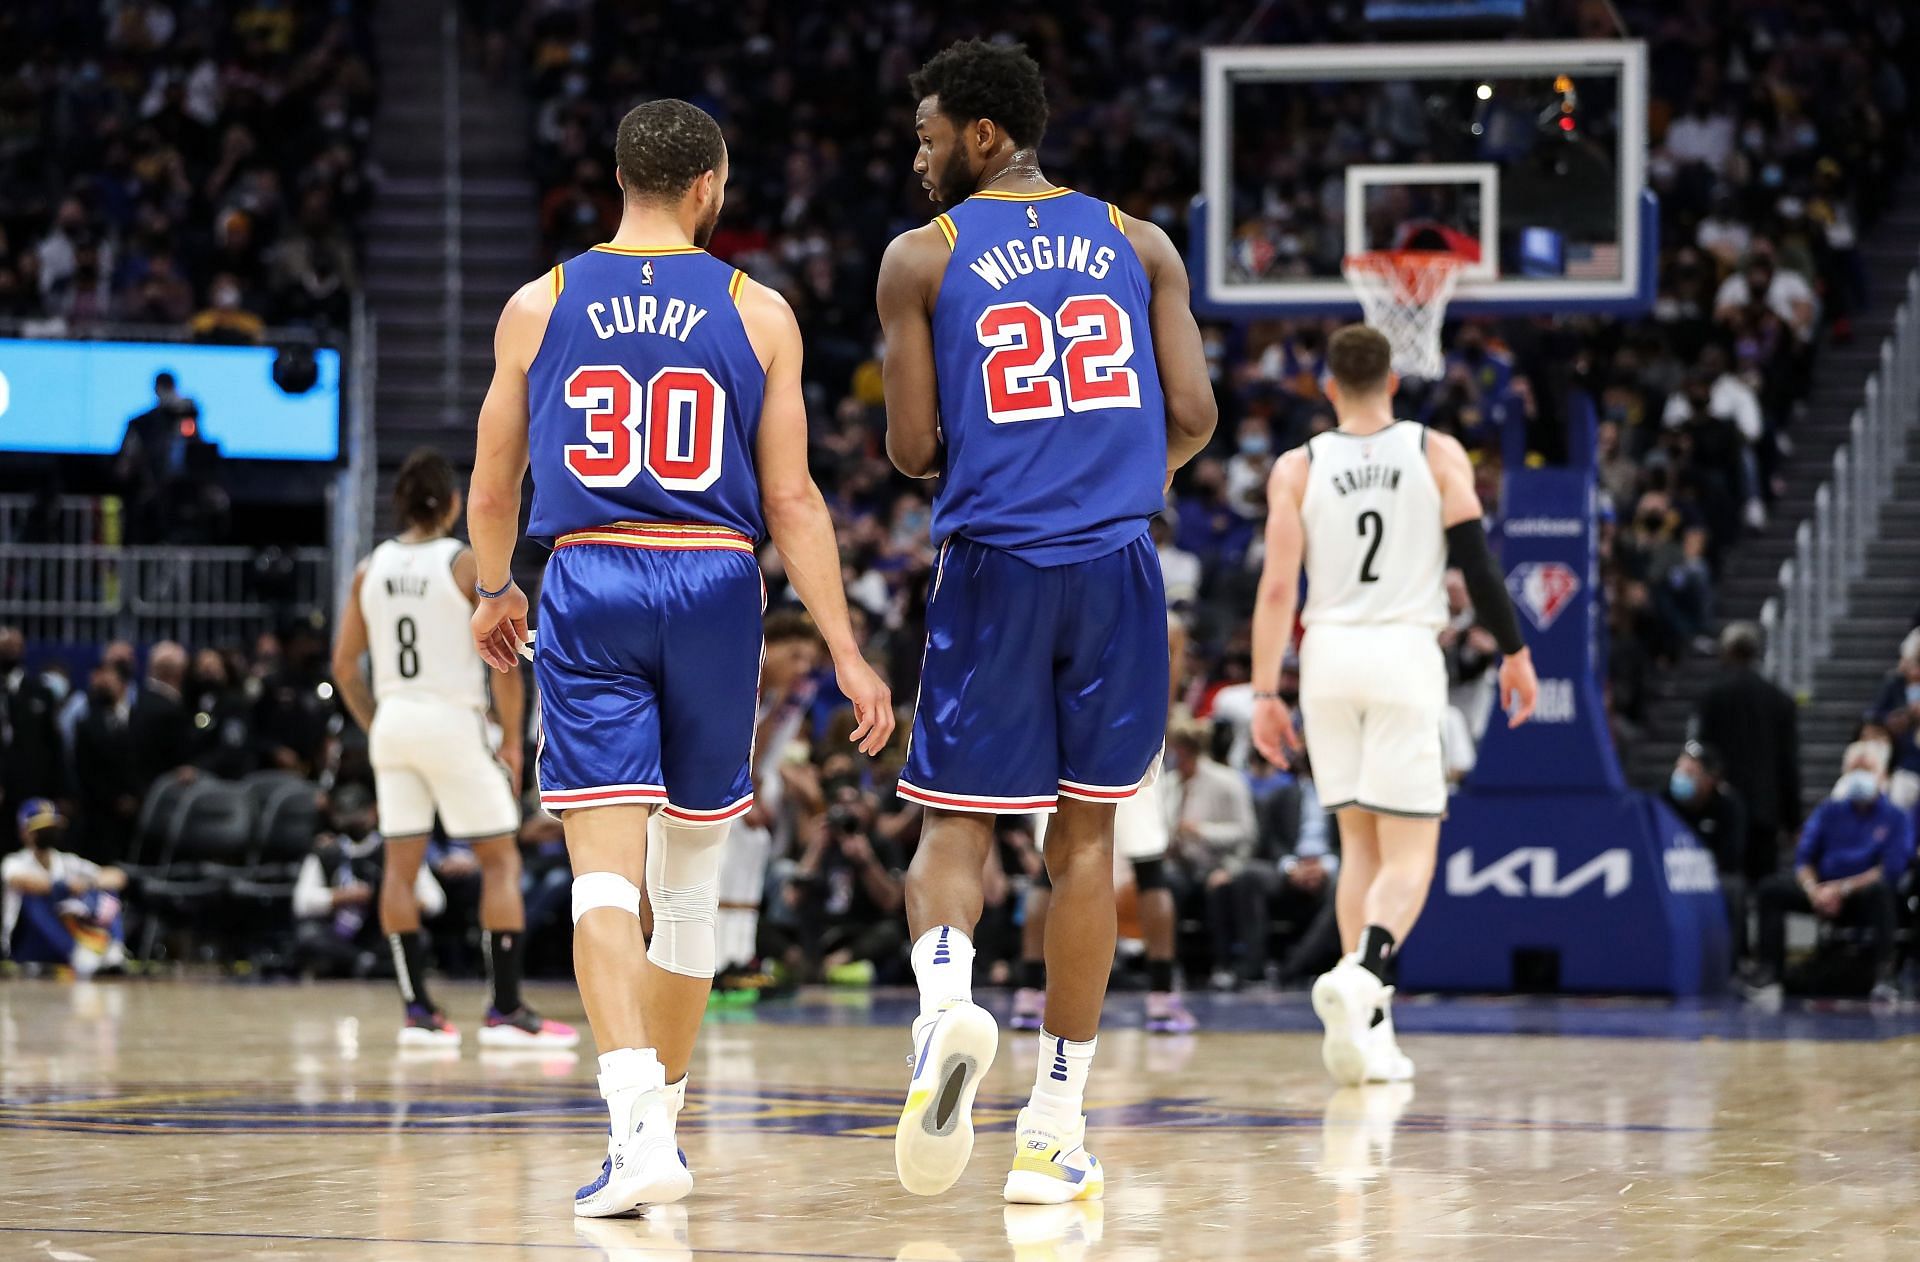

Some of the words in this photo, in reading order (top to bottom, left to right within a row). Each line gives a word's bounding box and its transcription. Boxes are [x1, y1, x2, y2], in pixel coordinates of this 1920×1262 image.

[968, 235, 1116, 291] WIGGINS
[586, 295, 708, 343] CURRY
[975, 293, 1142, 424] 22
[564, 365, 726, 492] 30
[1331, 464, 1402, 496] GRIFFIN
[1357, 510, 1383, 584] 2
[397, 616, 419, 679] 8
[1027, 1140, 1048, 1151] 22
